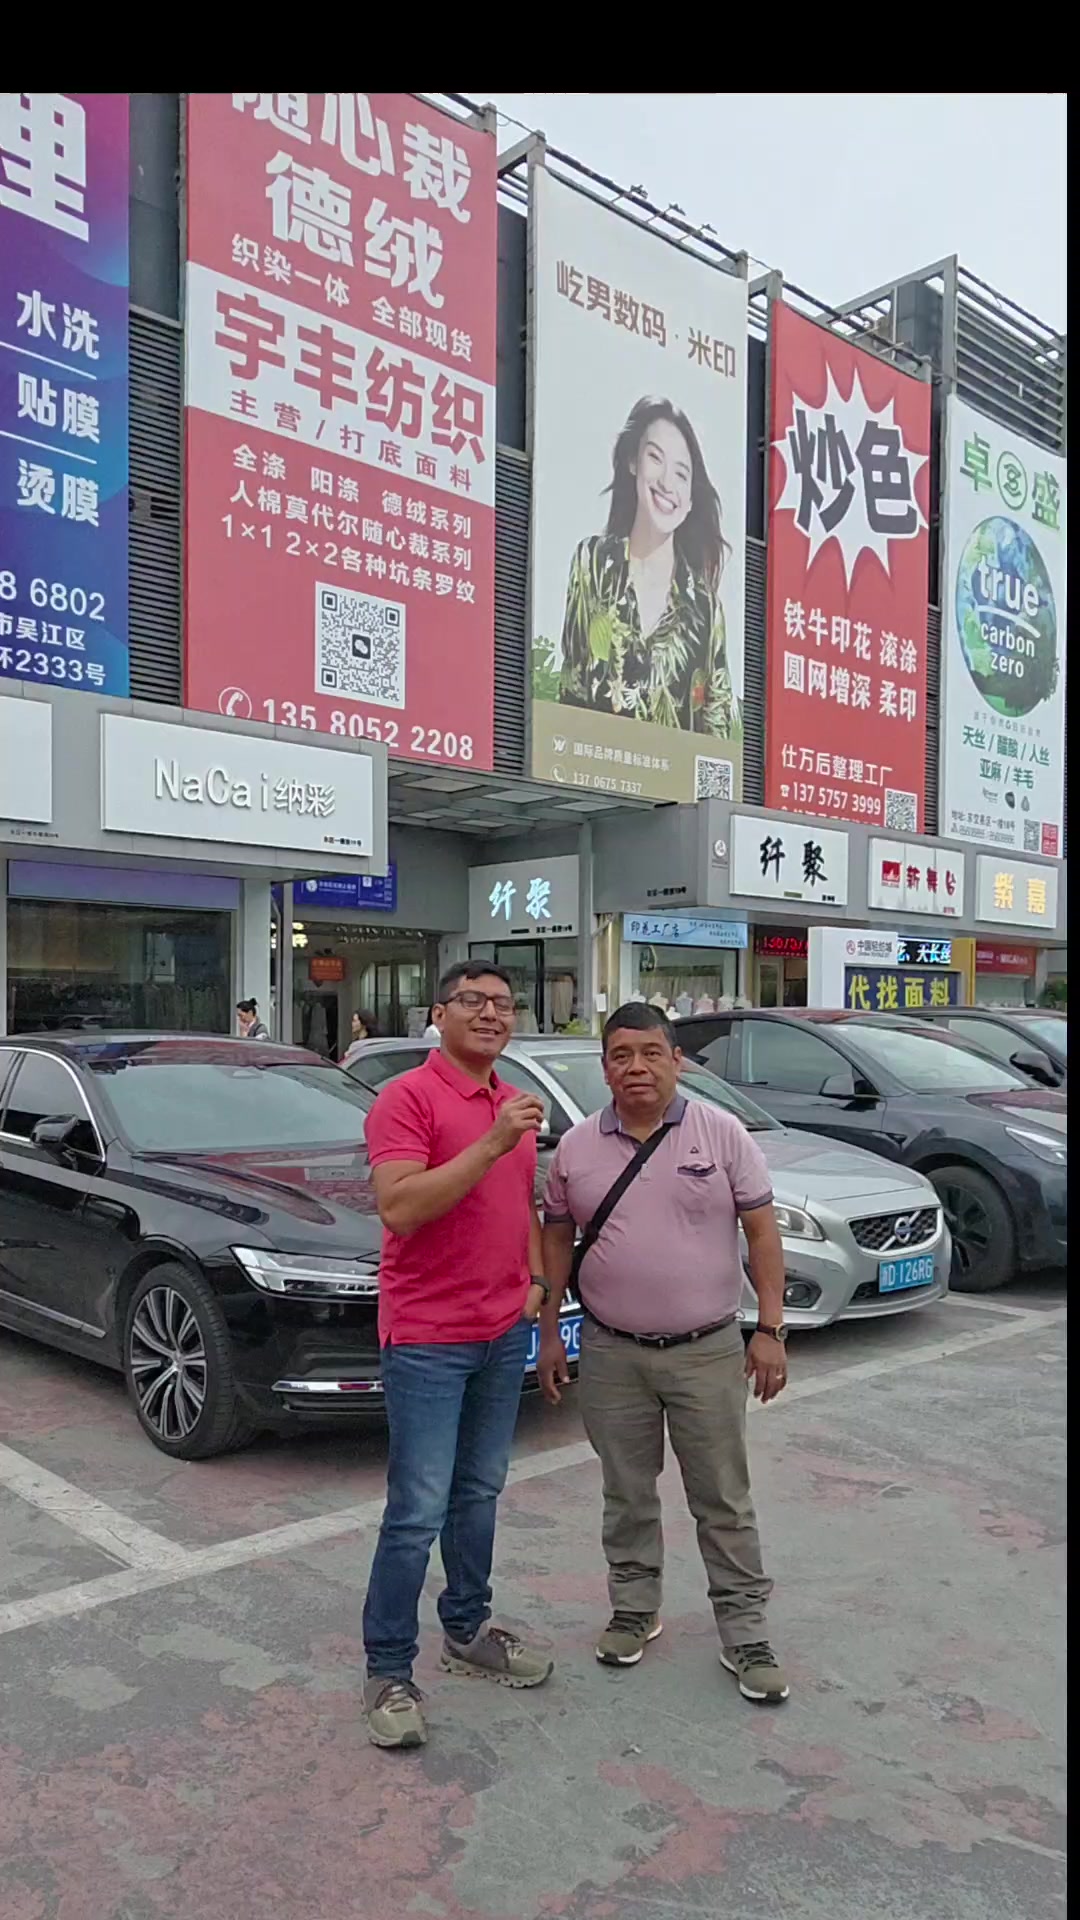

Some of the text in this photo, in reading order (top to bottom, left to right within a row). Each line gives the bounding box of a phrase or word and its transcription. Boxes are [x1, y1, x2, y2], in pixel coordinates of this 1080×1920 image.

[265, 149, 444, 309] 德绒
[16, 289, 100, 360] 水洗
[231, 233, 473, 362] 织染一体 全部现货
[16, 375, 100, 444] 贴膜
[215, 288, 486, 464] 宇丰纺织
[16, 458, 100, 527] 烫膜
[233, 444, 472, 539] 全涤 阳涤 德绒系列
[788, 408, 917, 535] 炒色
[230, 480, 472, 571] 人棉莫代尔随心裁系列
[30, 578, 105, 621] 6802
[977, 561, 1039, 616] true
[784, 598, 917, 674] 铁牛印花 滚涂
[981, 619, 1036, 658] carbon
[990, 651, 1024, 678] zero
[784, 651, 917, 722] 圆网增深 柔印
[263, 698, 474, 761] 135 8052 2208
[573, 772, 590, 786] 137
[781, 744, 892, 787] 仕万后整理工厂
[793, 782, 881, 815] 137 5757 3999
[848, 974, 950, 1010] 代找面料
